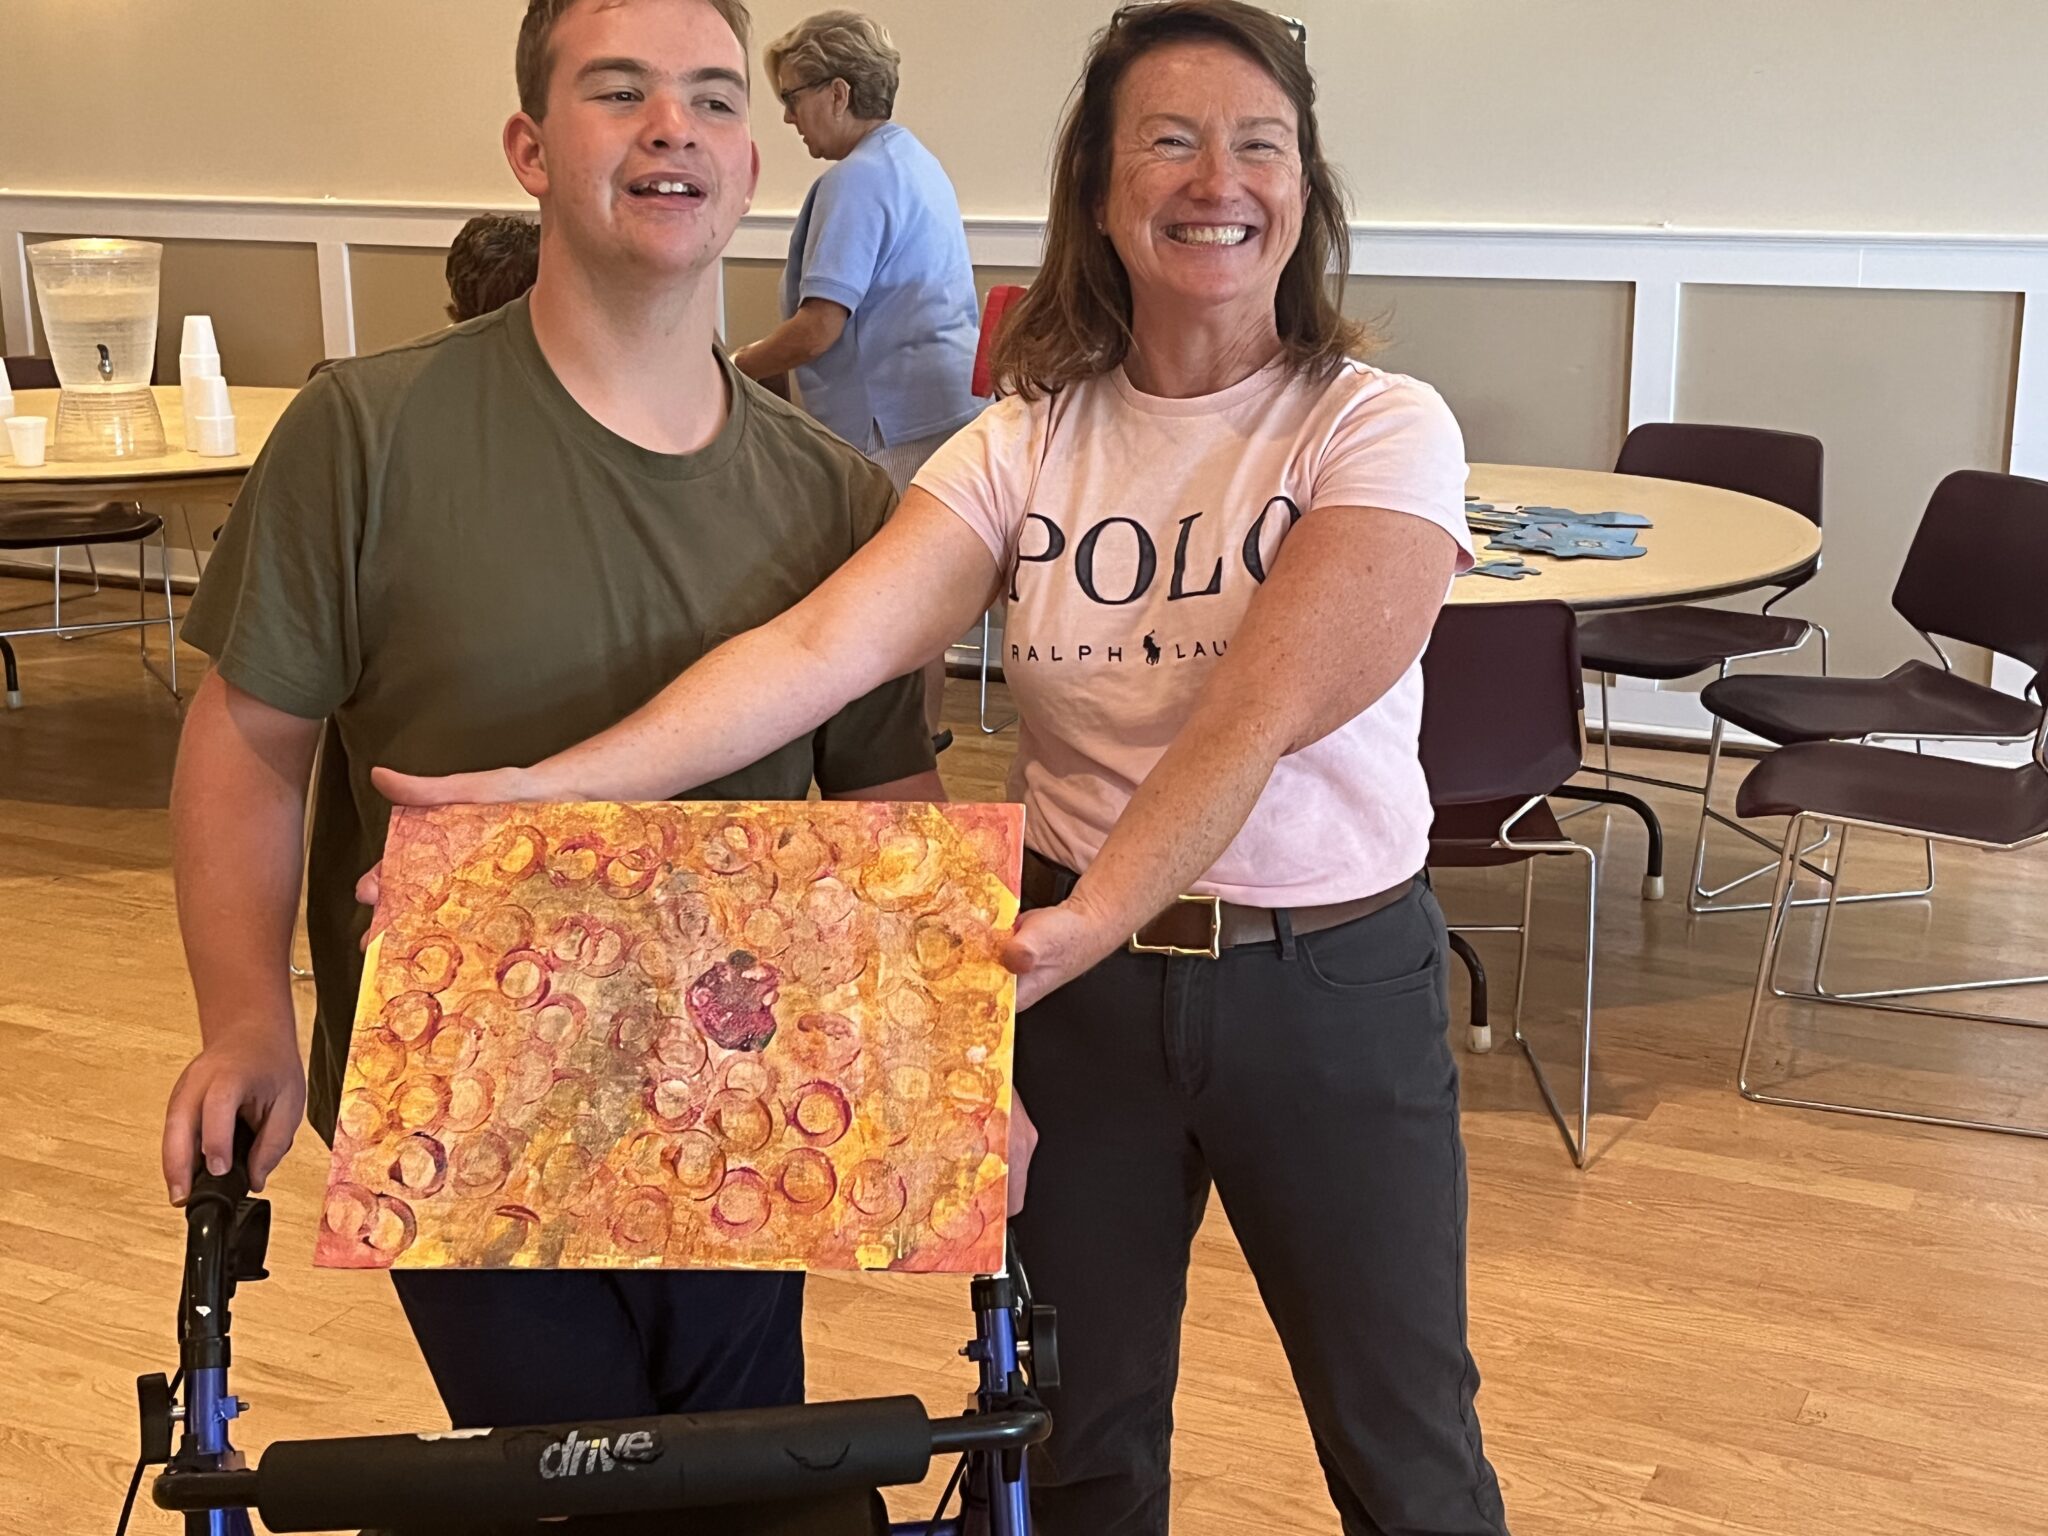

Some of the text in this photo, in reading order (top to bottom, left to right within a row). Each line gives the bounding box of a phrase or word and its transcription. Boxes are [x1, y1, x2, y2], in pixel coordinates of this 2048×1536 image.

[1008, 496, 1302, 605] POLO
[1011, 640, 1227, 662] RALPH LAU
[540, 1430, 654, 1479] drive
